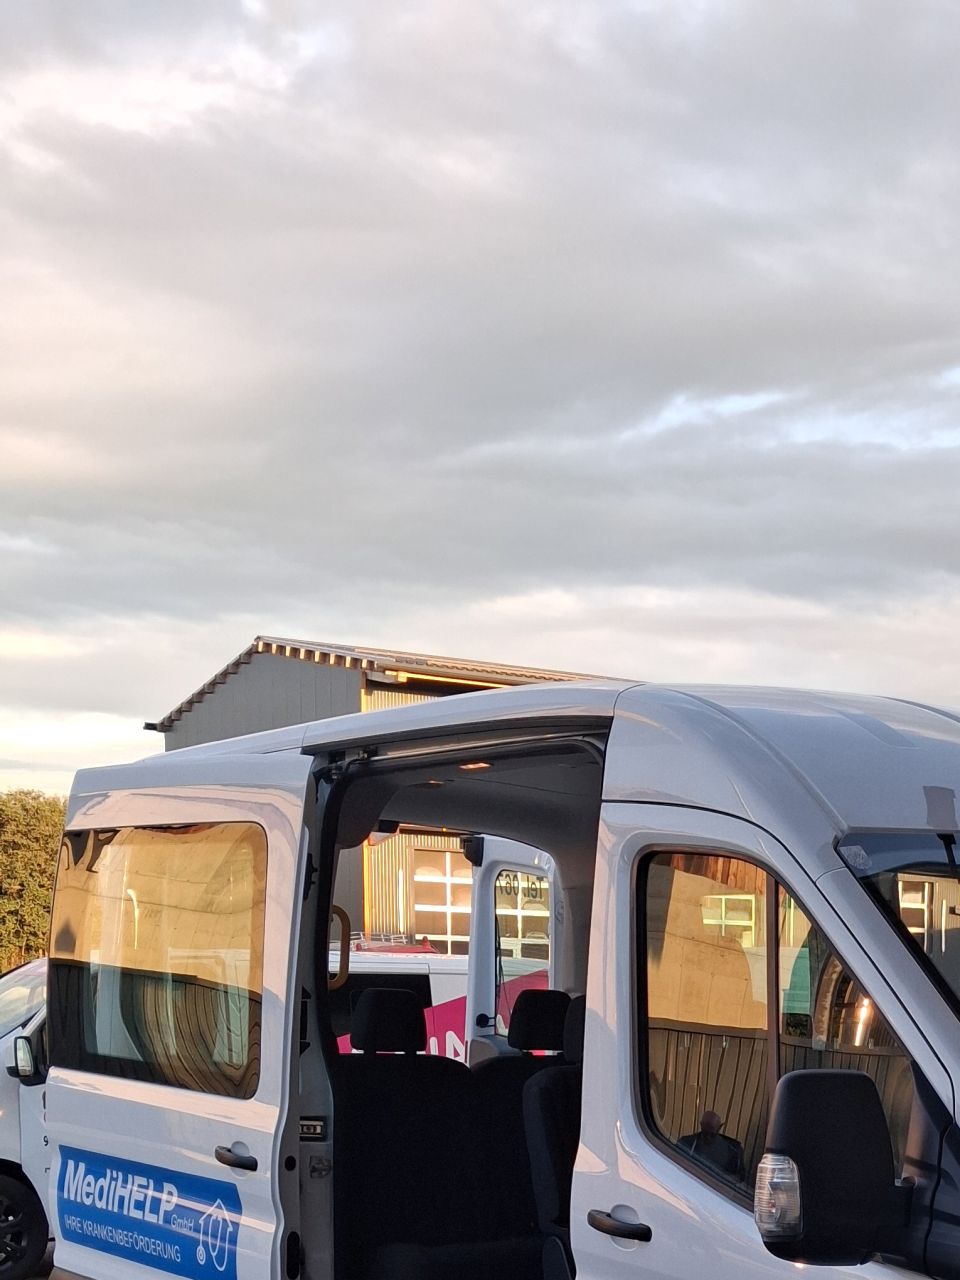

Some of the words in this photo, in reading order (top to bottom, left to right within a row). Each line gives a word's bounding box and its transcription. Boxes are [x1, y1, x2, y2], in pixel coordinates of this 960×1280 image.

[64, 1159, 178, 1224] MediHELP
[170, 1214, 195, 1232] GmbH
[64, 1214, 82, 1233] IHRE
[83, 1219, 181, 1262] KRANKENBEFÖRDERUNG
